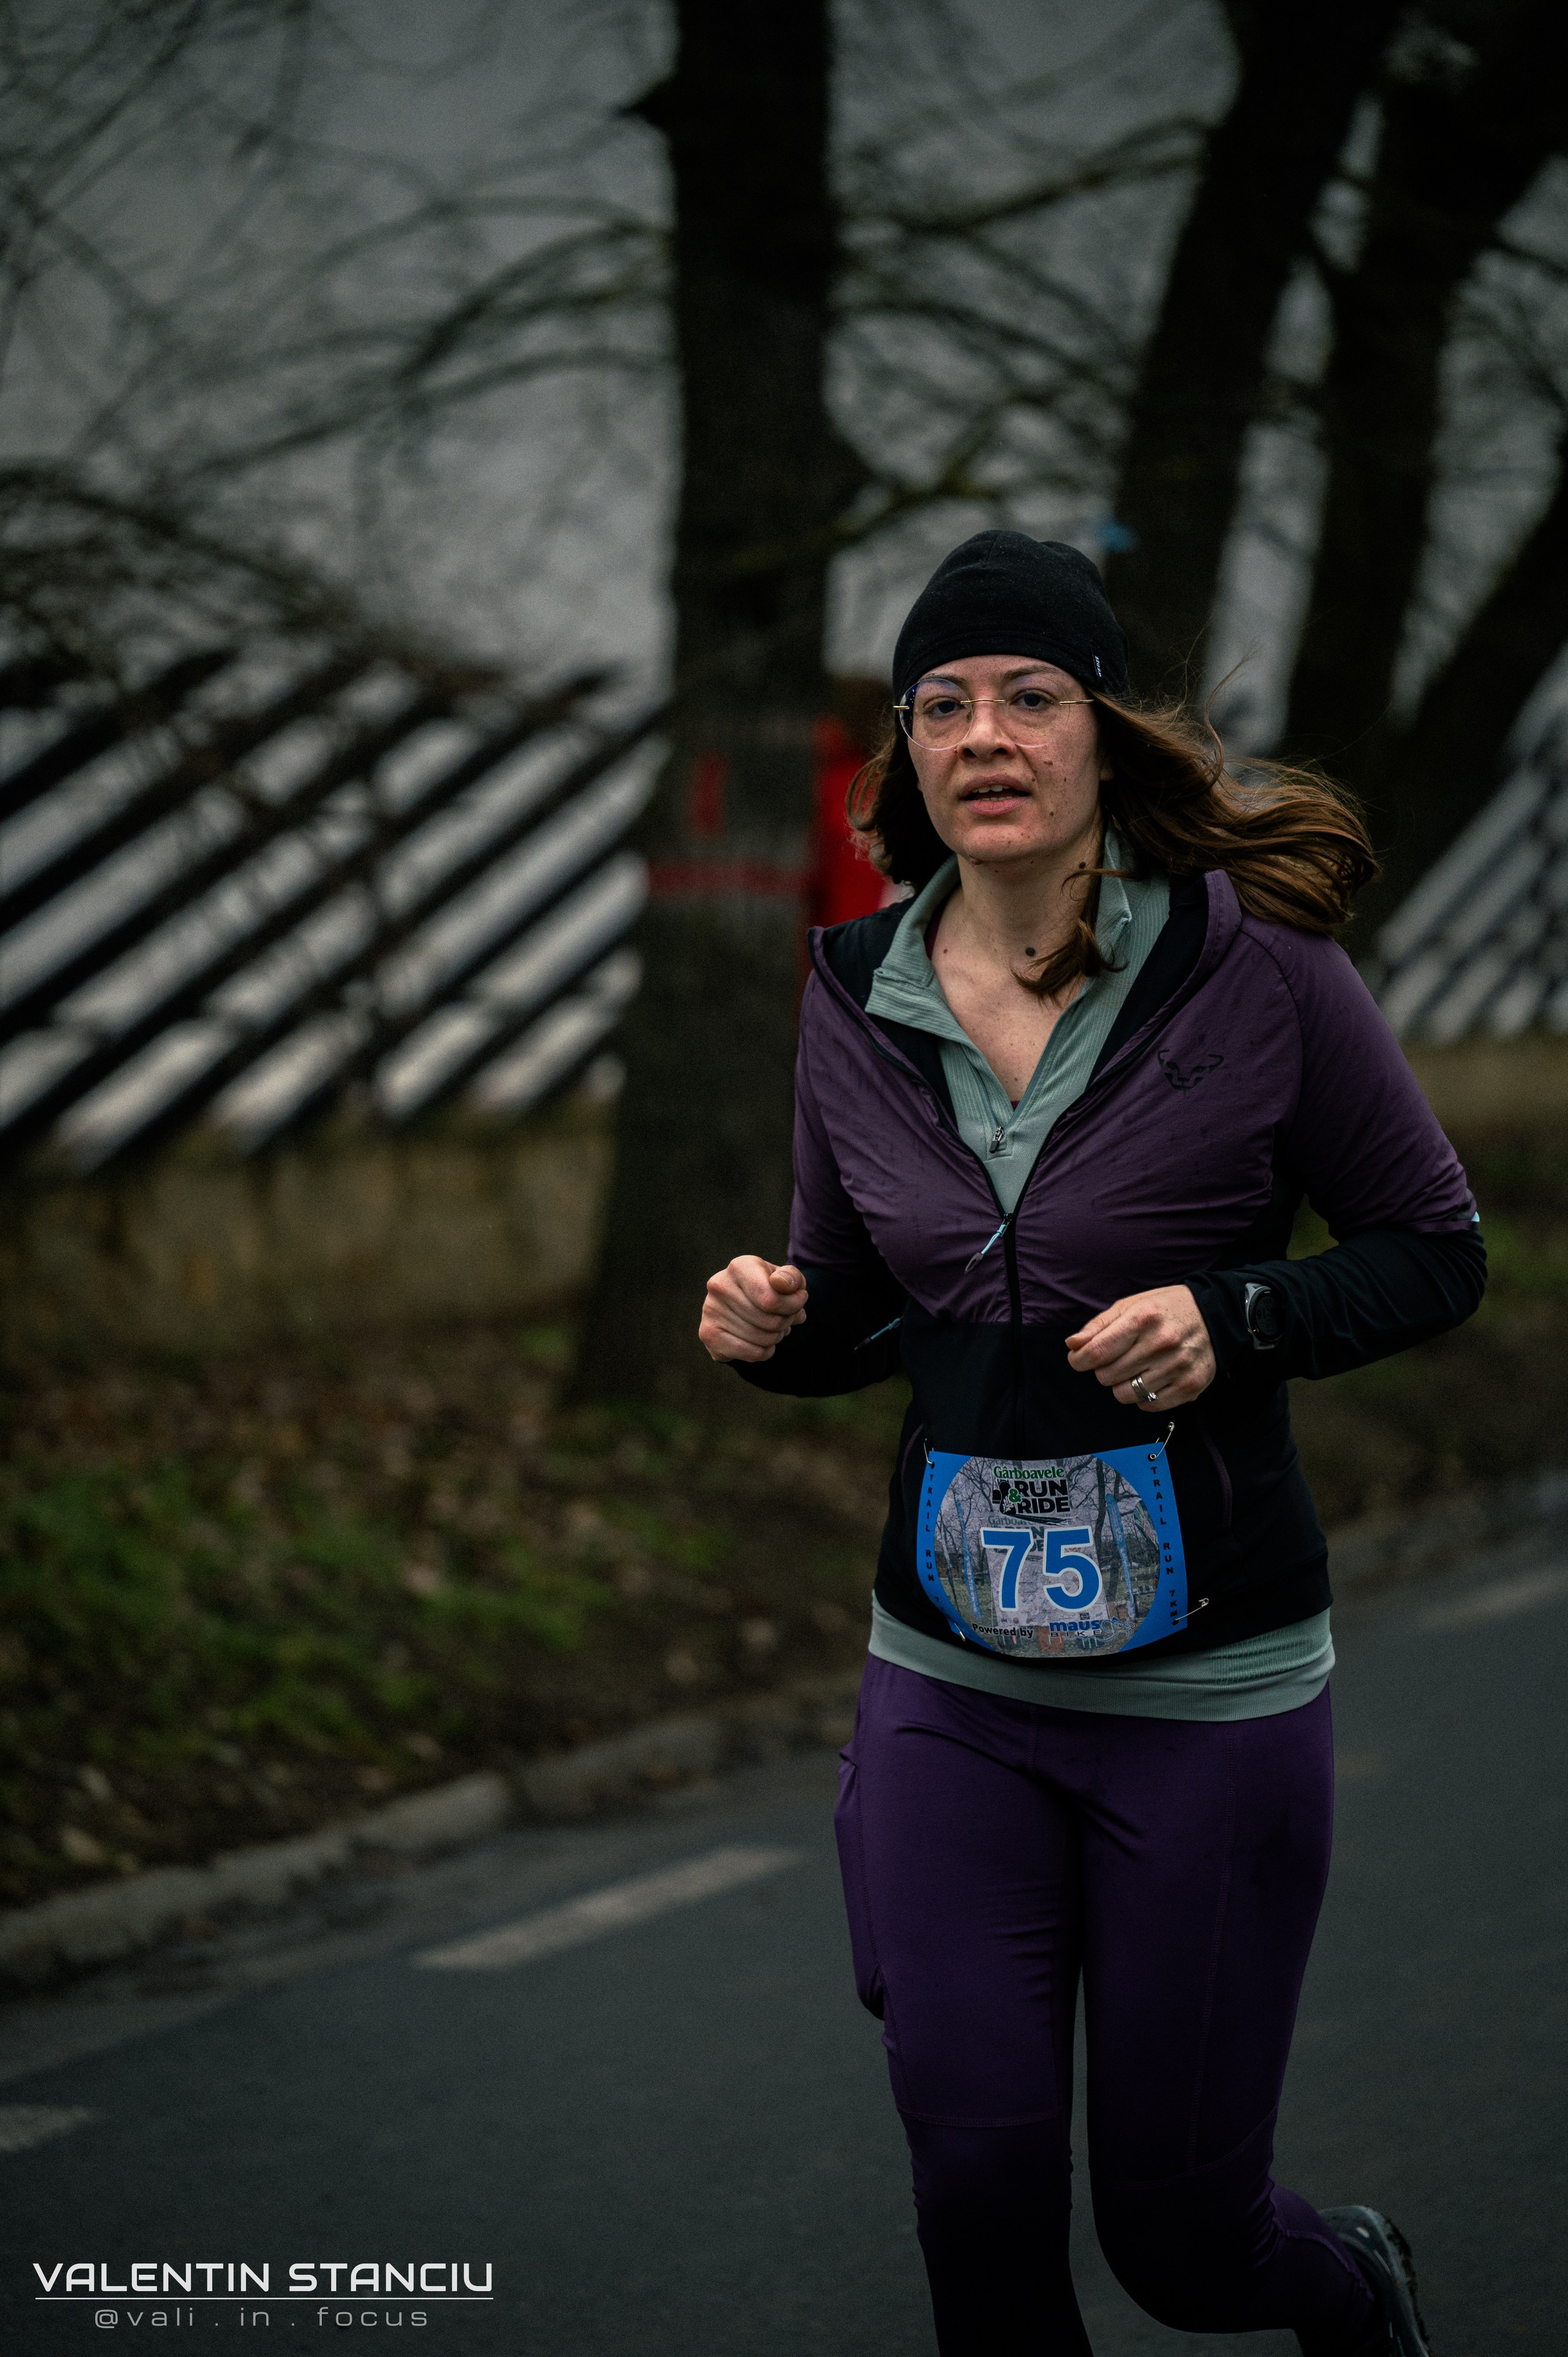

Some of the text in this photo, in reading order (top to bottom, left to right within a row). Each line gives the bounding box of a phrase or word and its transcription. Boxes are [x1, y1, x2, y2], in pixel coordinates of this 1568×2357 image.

[993, 1466, 1065, 1479] Gârboavele
[1009, 1489, 1070, 1514] & RIDE
[1014, 1479, 1068, 1497] RUN
[1150, 1466, 1166, 1525] TRAIL
[925, 1474, 934, 1532] TRAIL
[925, 1550, 934, 1581] RUN
[981, 1526, 1102, 1612] 75
[1163, 1542, 1174, 1574] RUN
[1169, 1590, 1178, 1617] 7KM
[972, 1623, 1033, 1639] Powered by
[1049, 1620, 1101, 1632] maus
